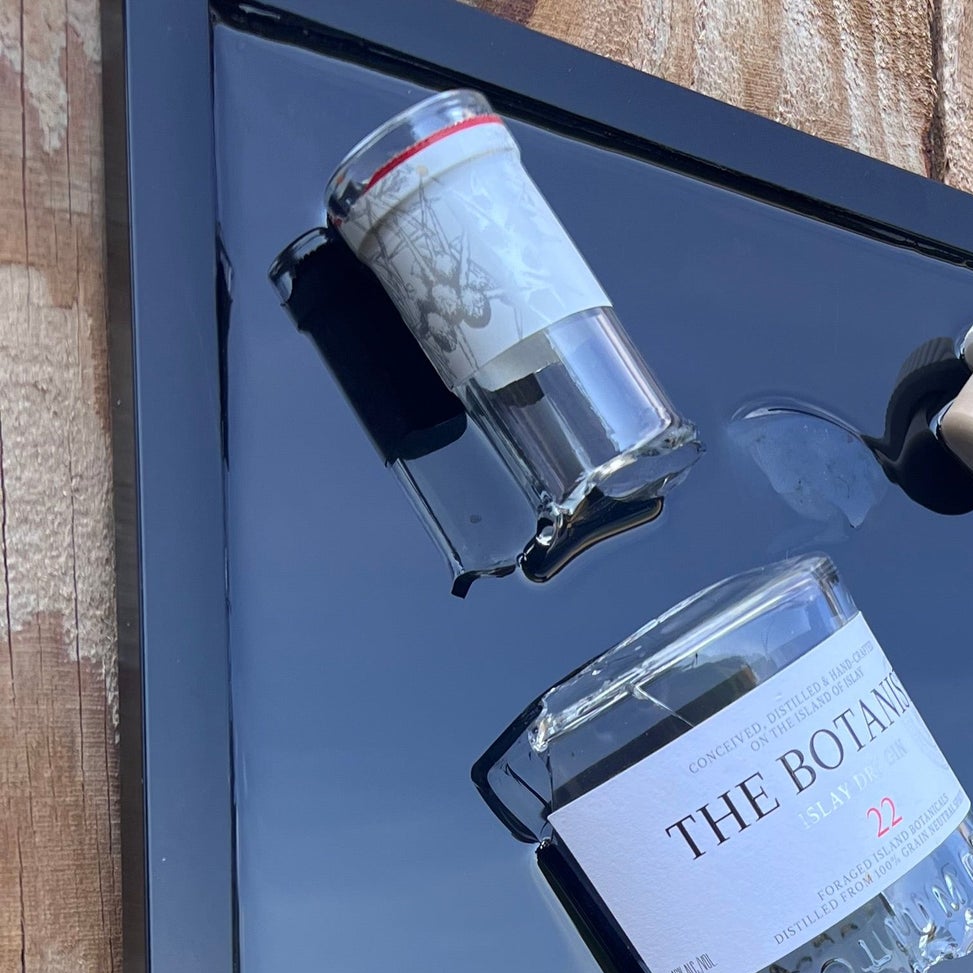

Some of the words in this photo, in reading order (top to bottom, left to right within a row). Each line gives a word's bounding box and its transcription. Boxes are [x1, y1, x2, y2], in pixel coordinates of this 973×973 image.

[689, 721, 767, 774] CONCEIVED,
[767, 682, 821, 724] DISTILLED
[750, 735, 769, 752] ON
[771, 717, 795, 738] THE
[794, 692, 832, 723] ISLAND
[832, 679, 845, 697] OF
[843, 666, 864, 688] ISLAY
[665, 771, 780, 860] THE
[776, 667, 909, 795] BOTANIS
[798, 781, 851, 830] ISLAY
[817, 859, 872, 901] FORAGED
[873, 830, 909, 863] ISLAND
[909, 793, 949, 837] BOTANICALS
[866, 797, 903, 838] 22
[773, 899, 839, 945] DISTILLED
[840, 874, 873, 903] FROM
[875, 855, 901, 879] 100%
[901, 831, 929, 858] GRAIN
